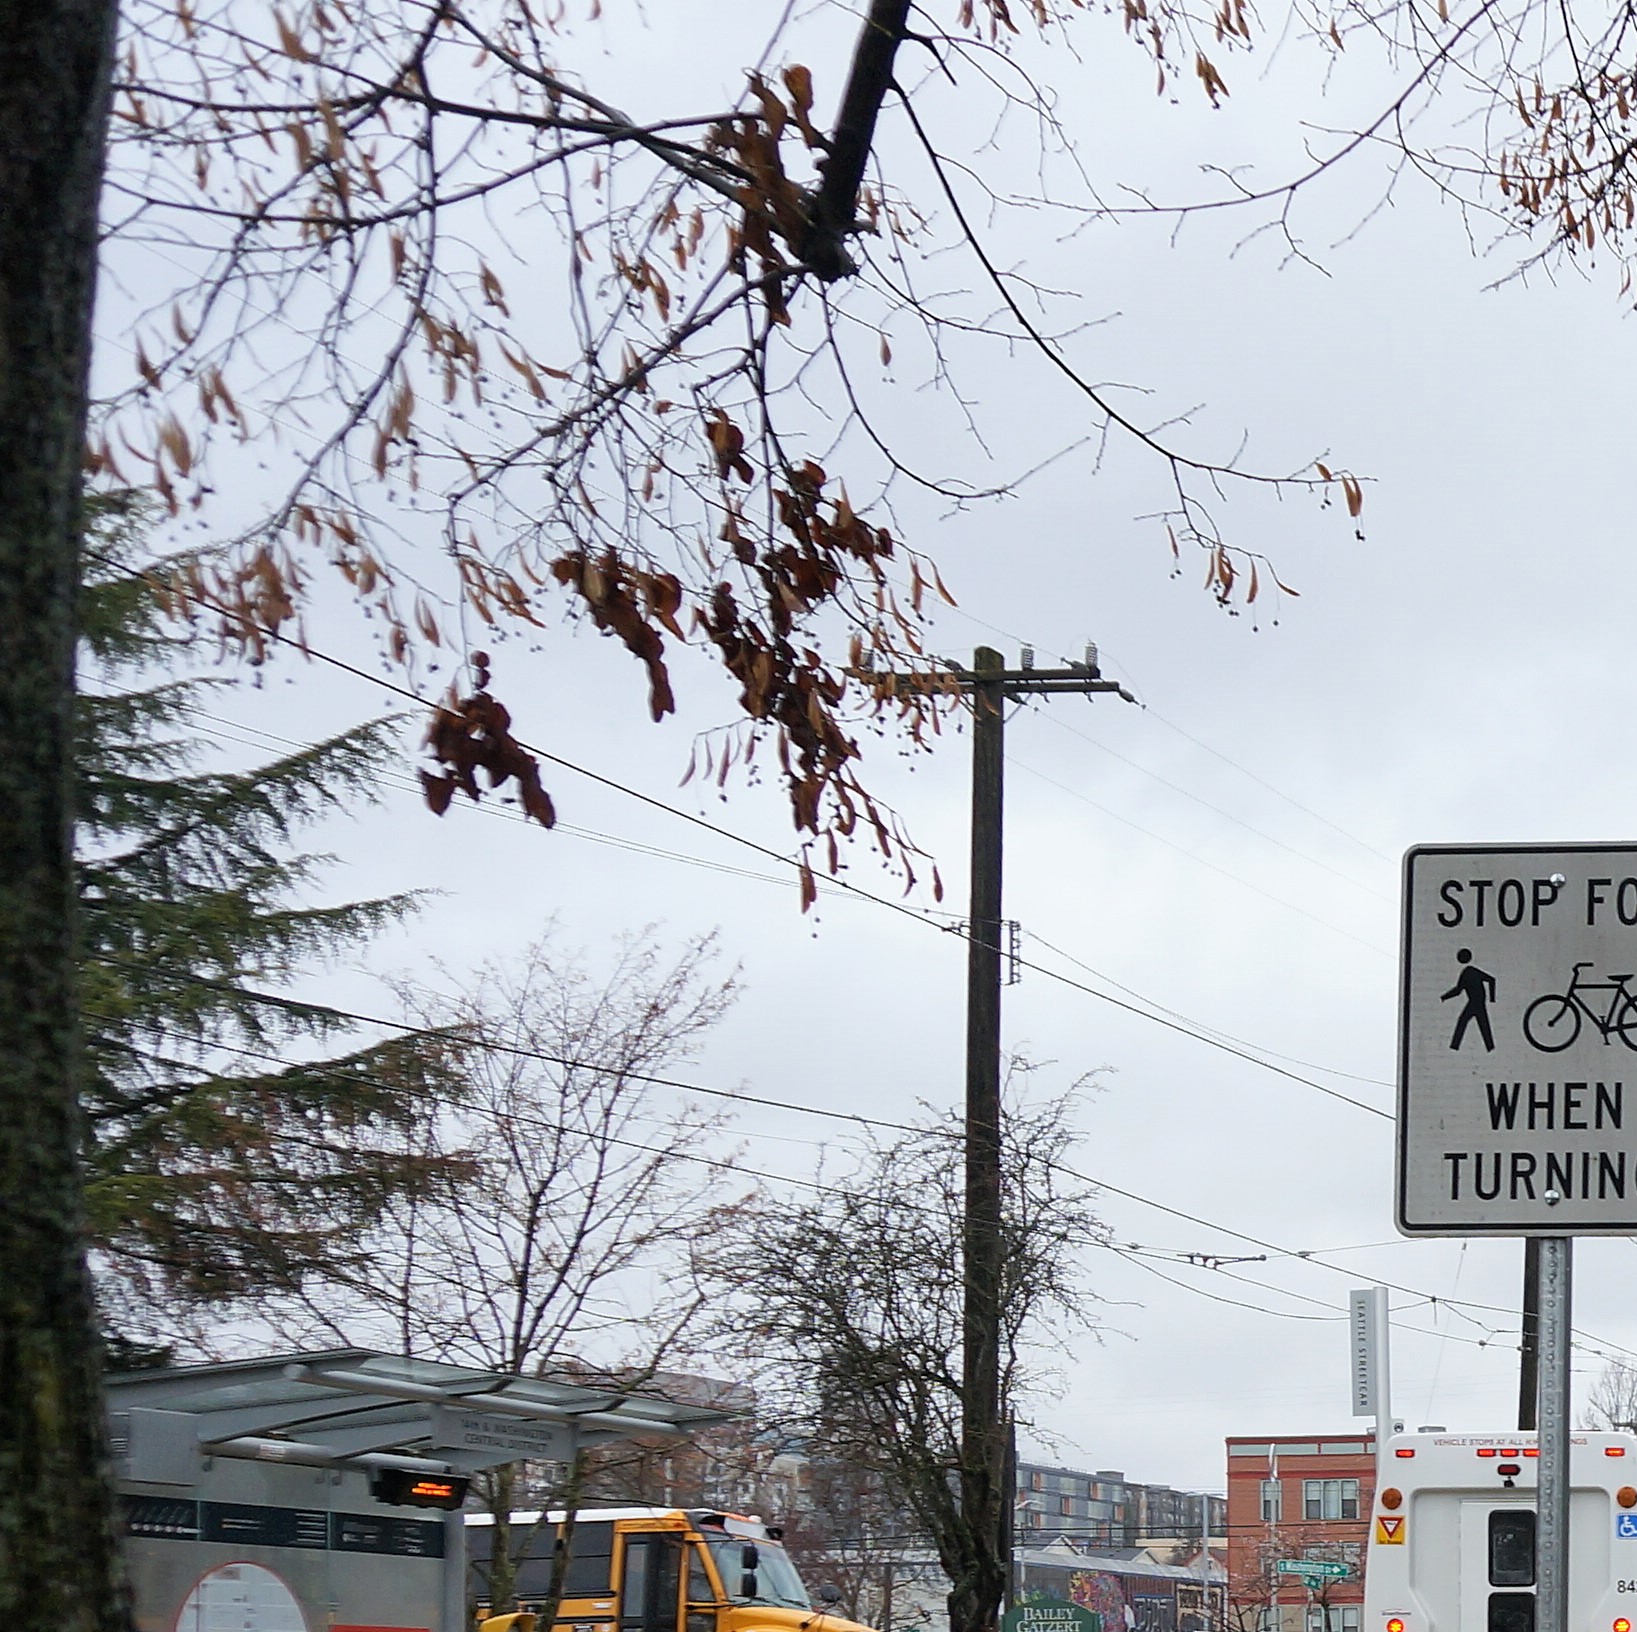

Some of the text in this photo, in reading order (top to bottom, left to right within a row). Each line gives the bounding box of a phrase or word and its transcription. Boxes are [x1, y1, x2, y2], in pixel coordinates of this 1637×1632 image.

[1437, 878, 1559, 927] STOP
[1486, 1082, 1623, 1130] WHEN
[1357, 1301, 1368, 1406] SEATTLE STREETCAR
[1509, 1438, 1523, 1446] ALL
[1023, 1607, 1075, 1620] BAILEY
